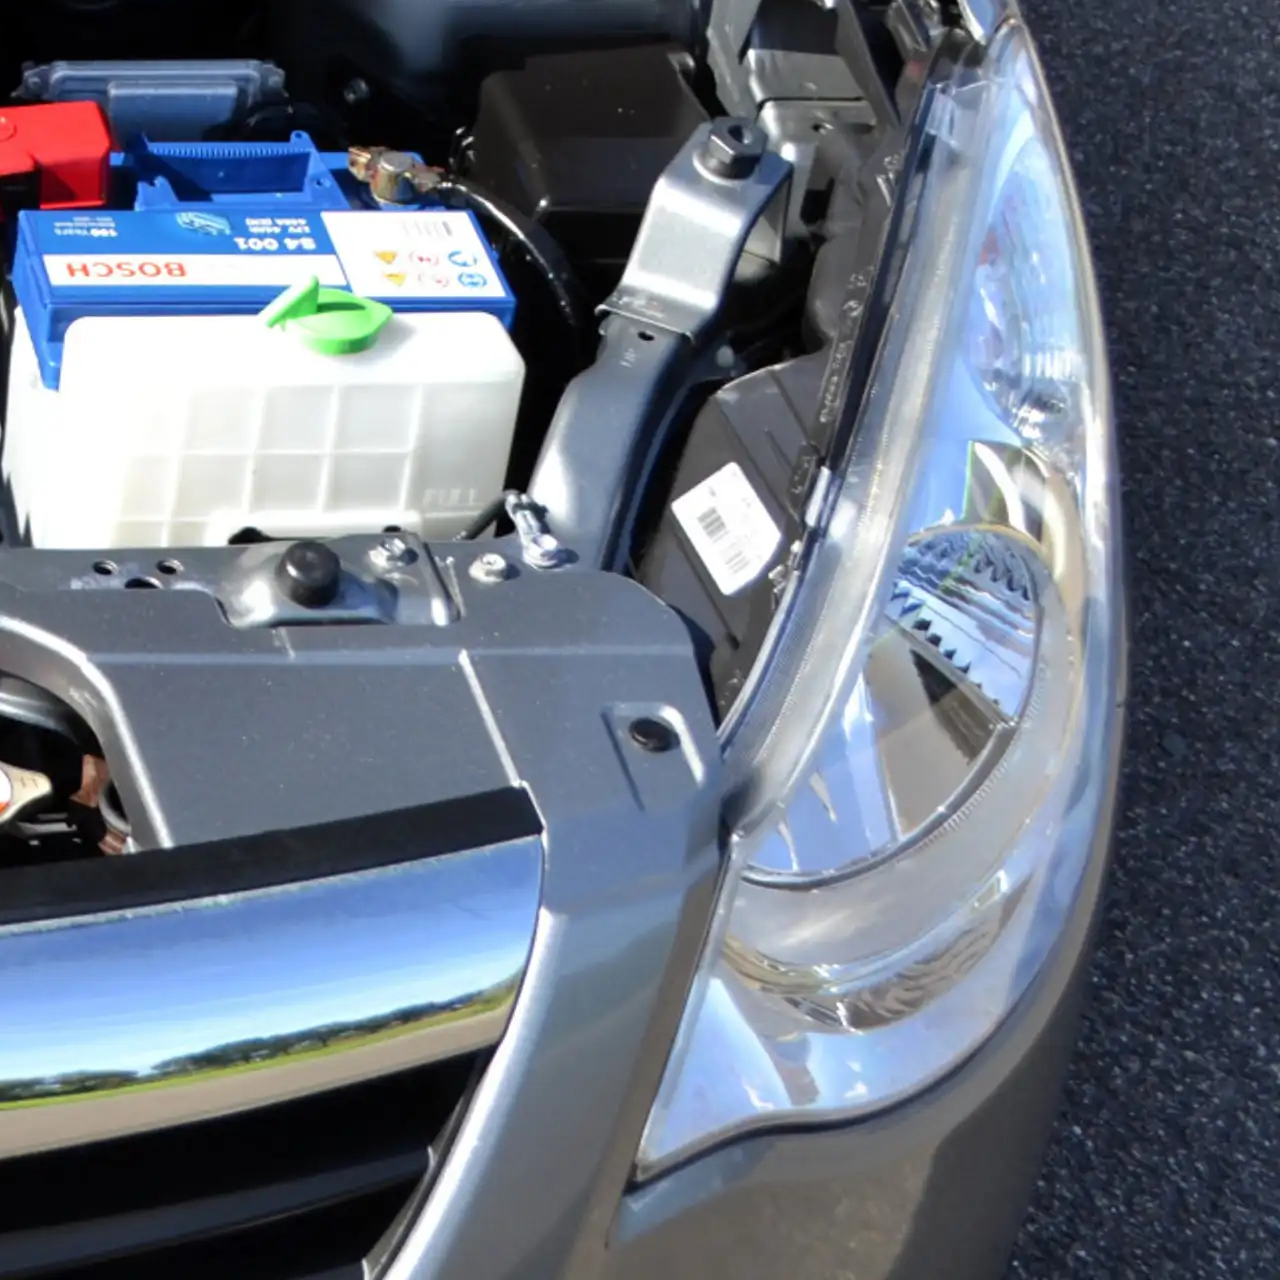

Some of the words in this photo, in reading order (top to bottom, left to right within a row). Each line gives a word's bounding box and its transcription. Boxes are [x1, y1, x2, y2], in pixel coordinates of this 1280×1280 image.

[233, 236, 280, 251] 001
[283, 236, 317, 251] S4
[66, 261, 188, 278] BOSCH
